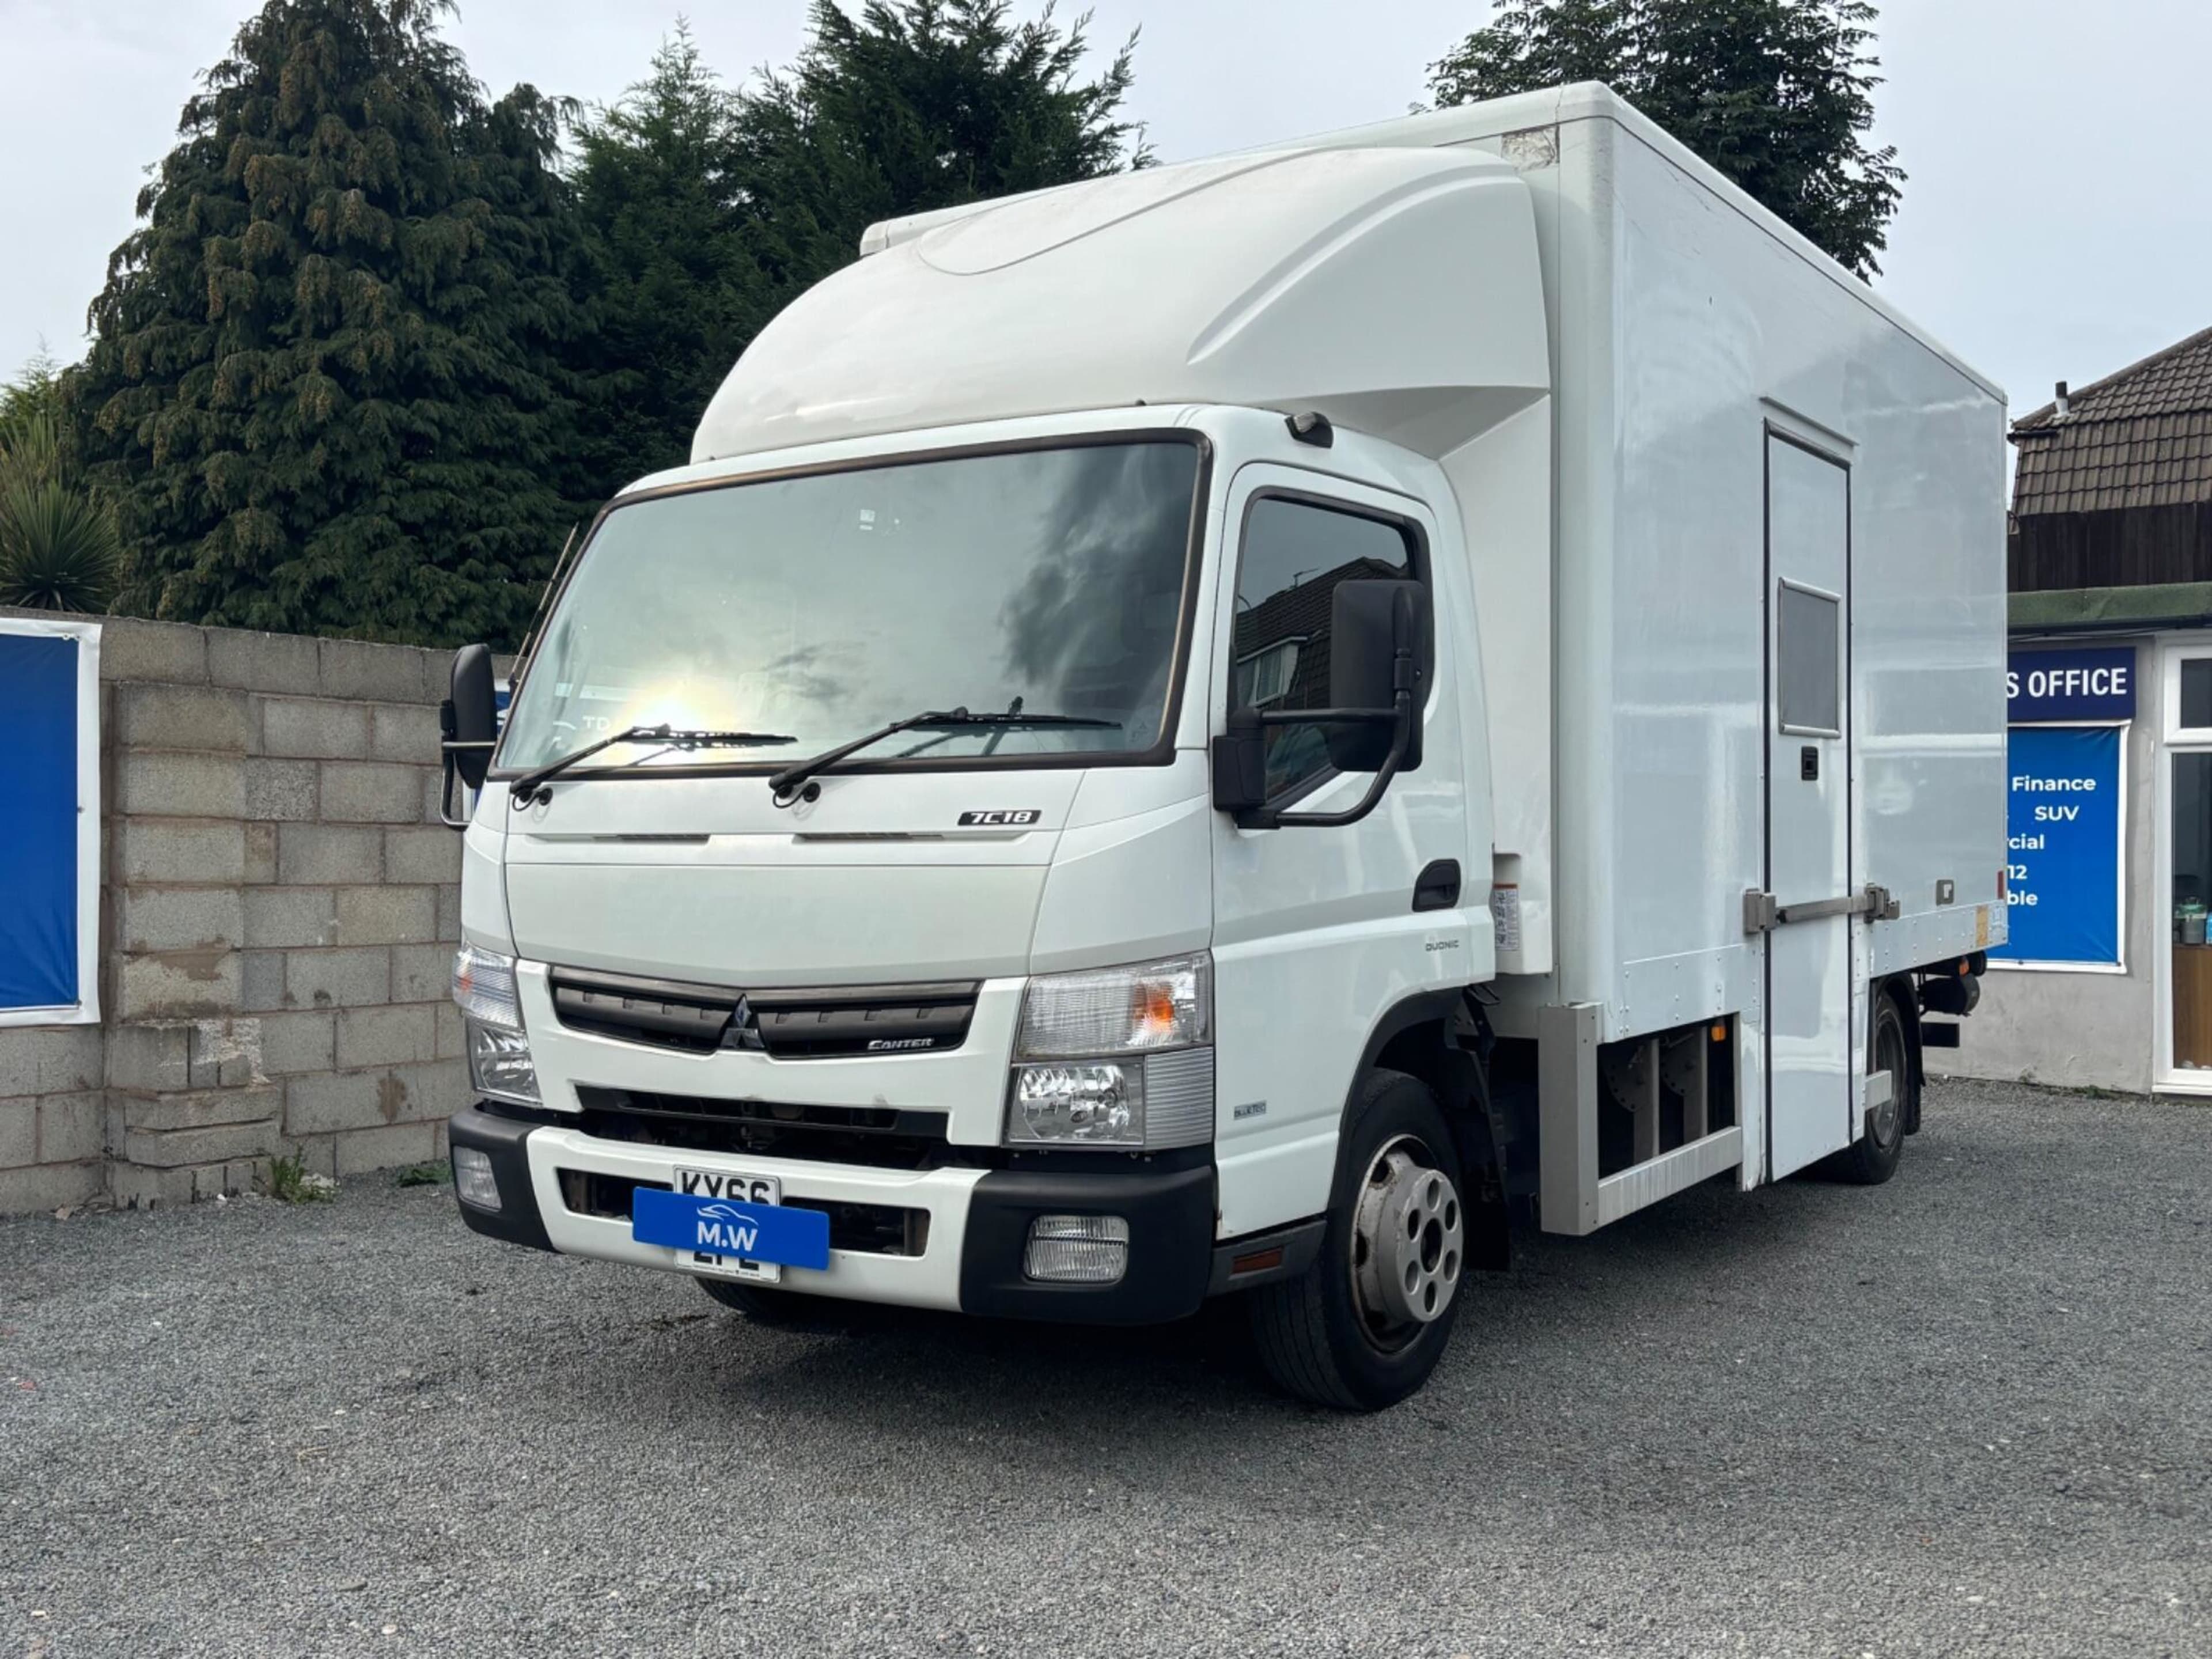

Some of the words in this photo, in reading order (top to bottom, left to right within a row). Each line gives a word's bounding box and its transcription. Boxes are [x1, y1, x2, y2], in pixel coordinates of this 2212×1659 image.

[2028, 667, 2127, 698] OFFICE
[2012, 775, 2096, 792] Finance
[970, 810, 1032, 824] 7C18
[2034, 805, 2079, 821] SUV
[2007, 833, 2045, 850] cial
[2007, 890, 2038, 906] ble
[697, 1221, 758, 1252] M.W
